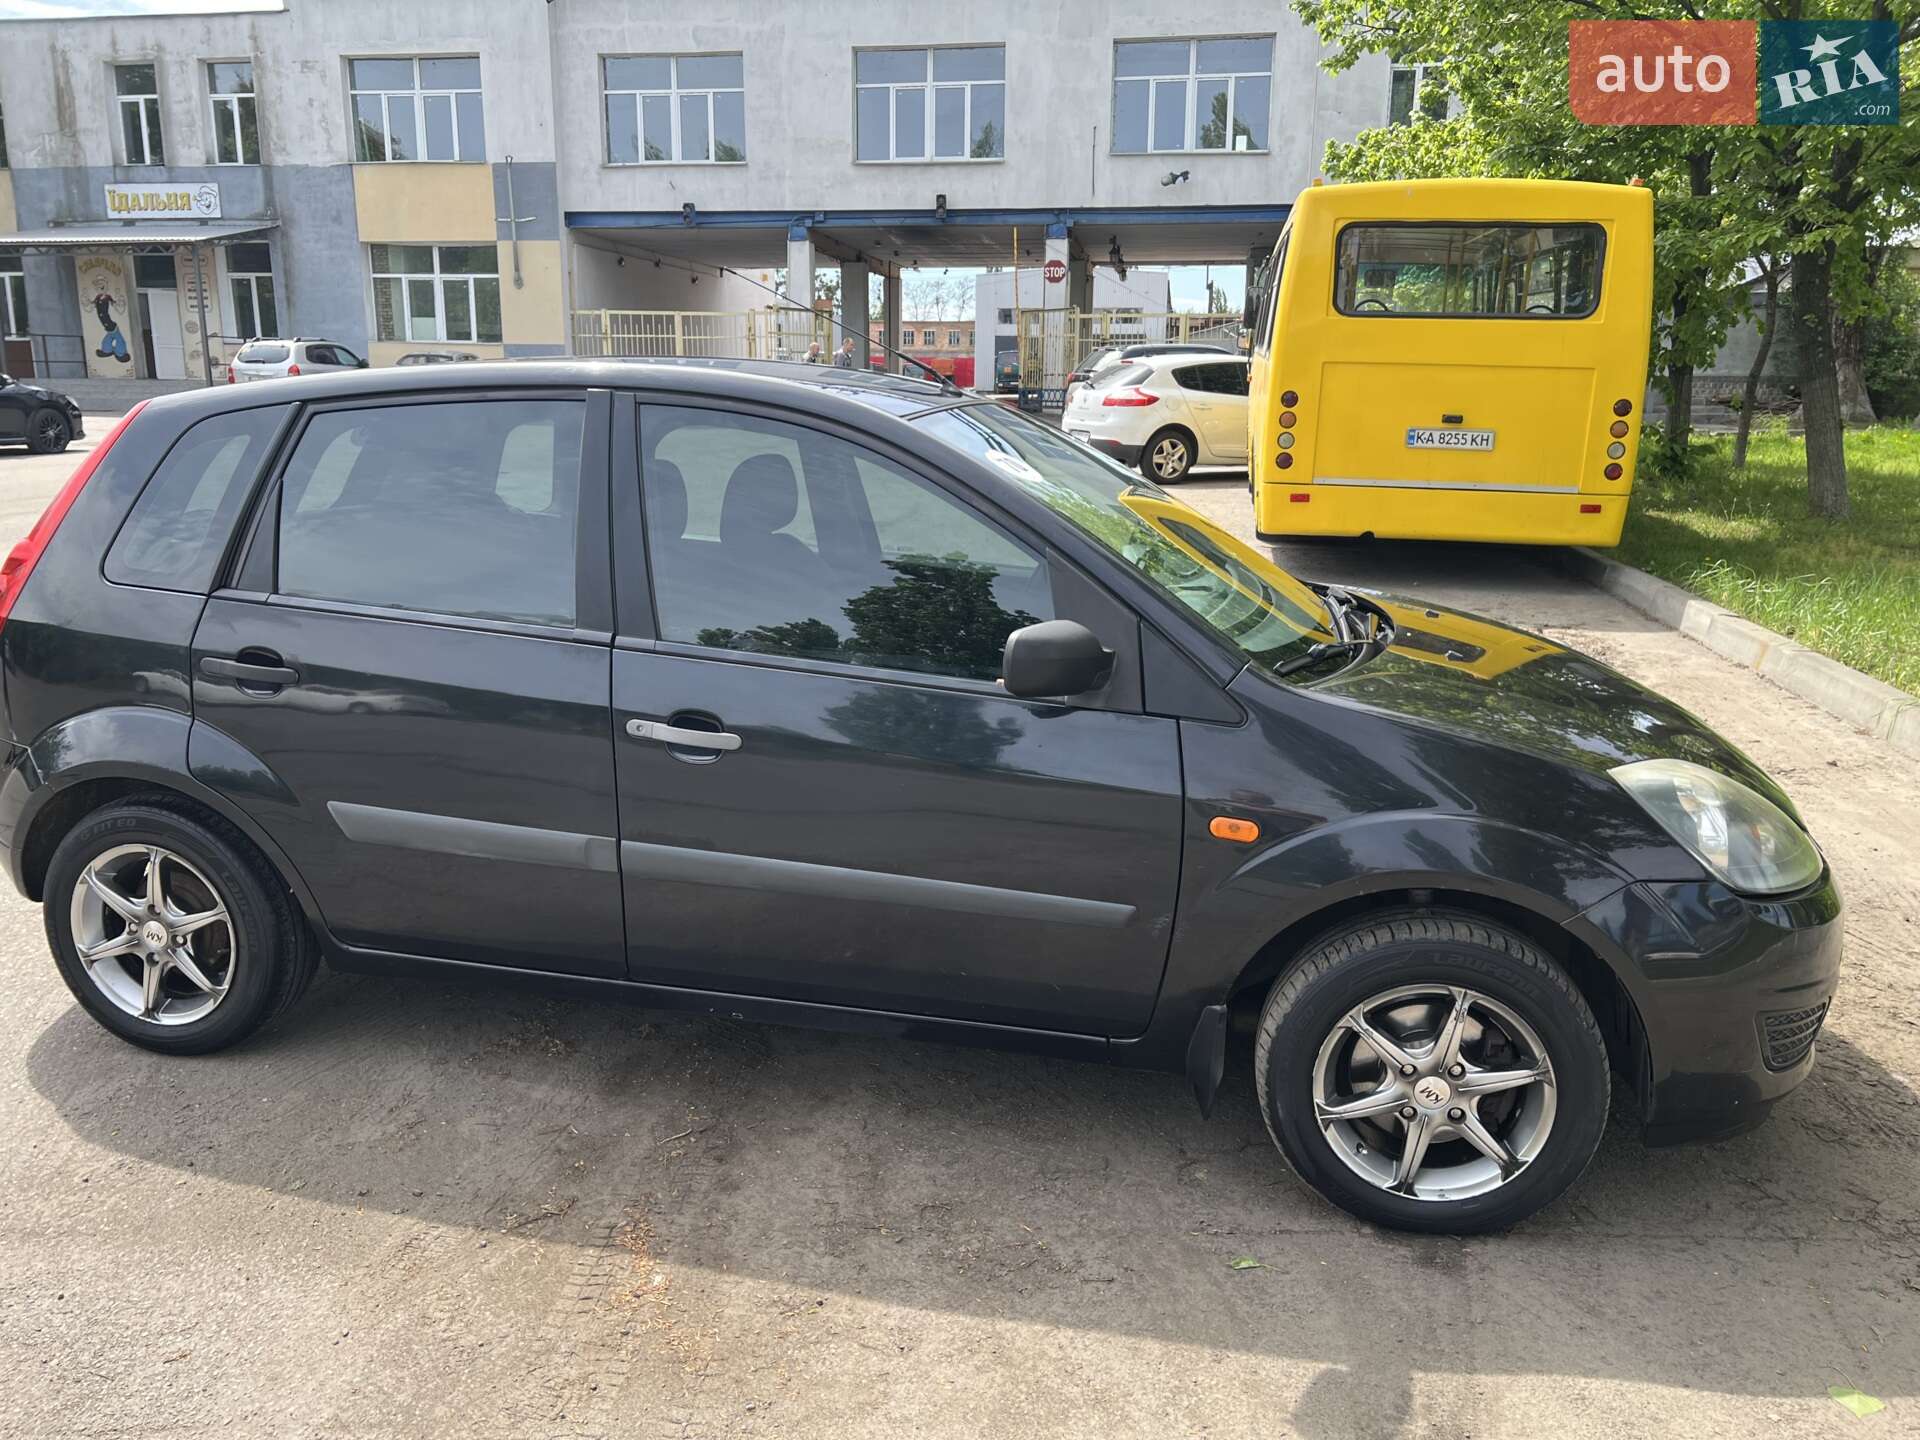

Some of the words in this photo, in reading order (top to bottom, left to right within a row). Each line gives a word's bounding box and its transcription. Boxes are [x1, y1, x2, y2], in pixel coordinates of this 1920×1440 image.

[107, 189, 192, 214] ЇДАЛЬНЯ
[1044, 266, 1066, 278] STOP
[1438, 433, 1467, 445] 8255
[1470, 434, 1490, 446] KH
[146, 930, 162, 943] KM
[1419, 1086, 1444, 1104] KM
